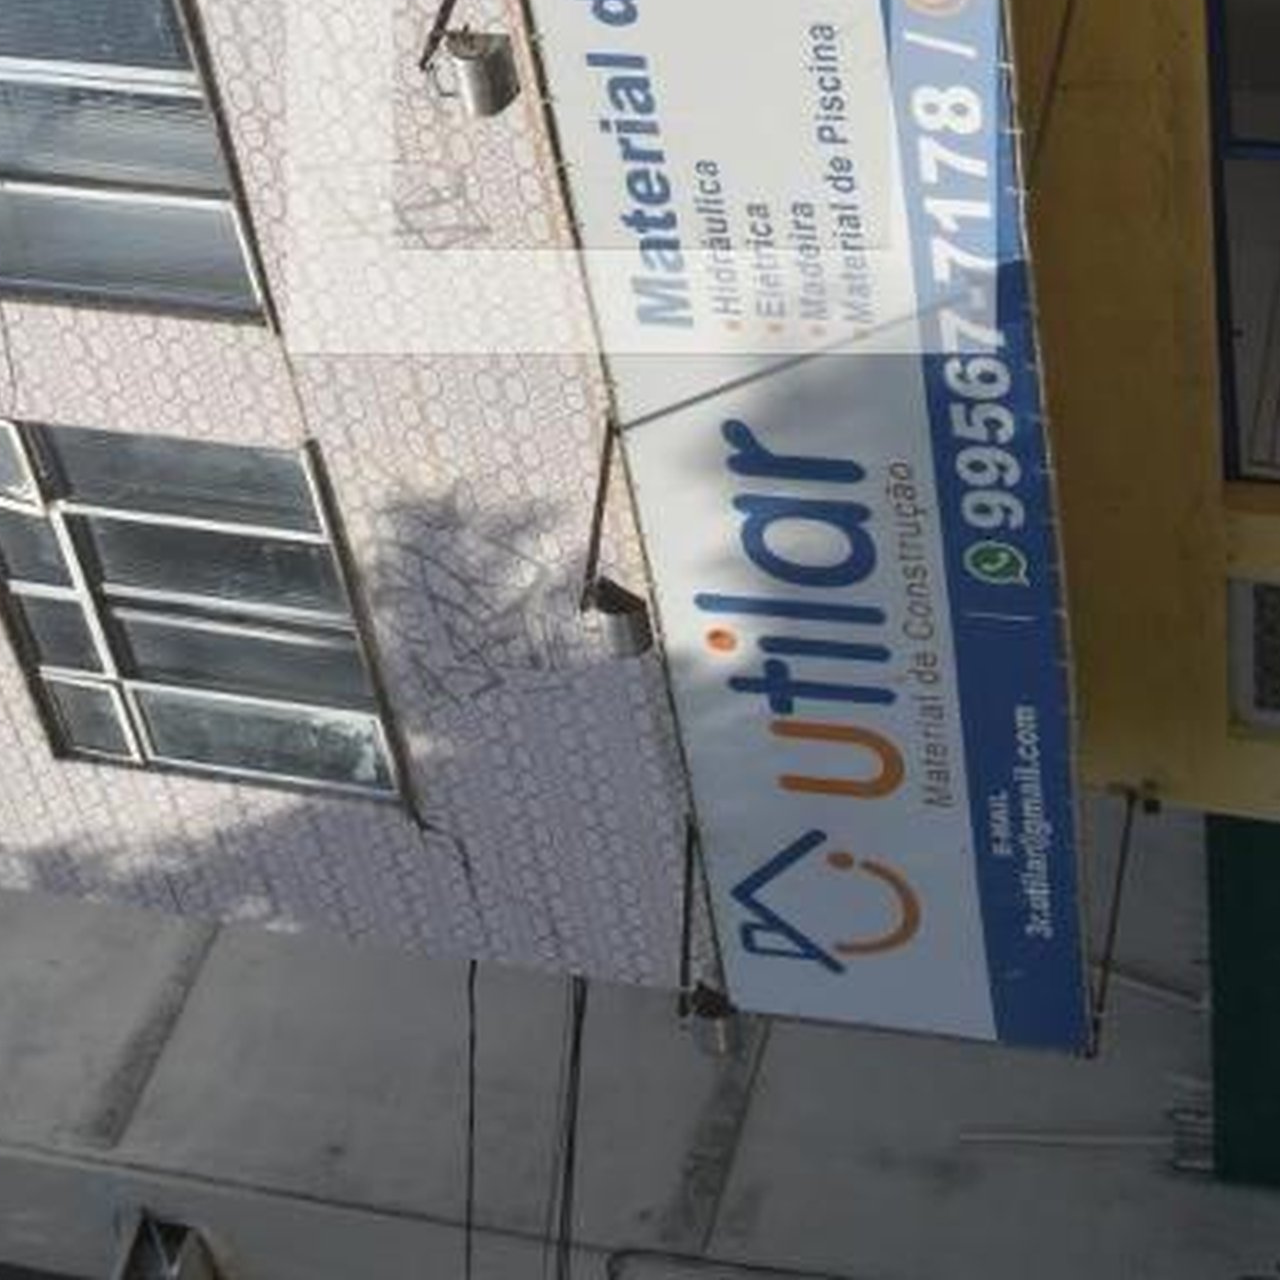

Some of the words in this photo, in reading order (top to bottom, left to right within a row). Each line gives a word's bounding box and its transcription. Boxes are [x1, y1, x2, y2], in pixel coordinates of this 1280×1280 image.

[808, 23, 849, 144] Piscina
[586, 52, 695, 329] Material
[825, 156, 856, 194] de
[693, 159, 742, 316] Hidráulica
[788, 200, 828, 321] Madeira
[829, 201, 873, 324] Material
[910, 85, 1022, 528] 99567-7178
[694, 419, 905, 798] utilar
[884, 461, 936, 641] Construção
[907, 650, 939, 685] de
[923, 694, 953, 809] Material
[988, 788, 1013, 857] E-MAIL
